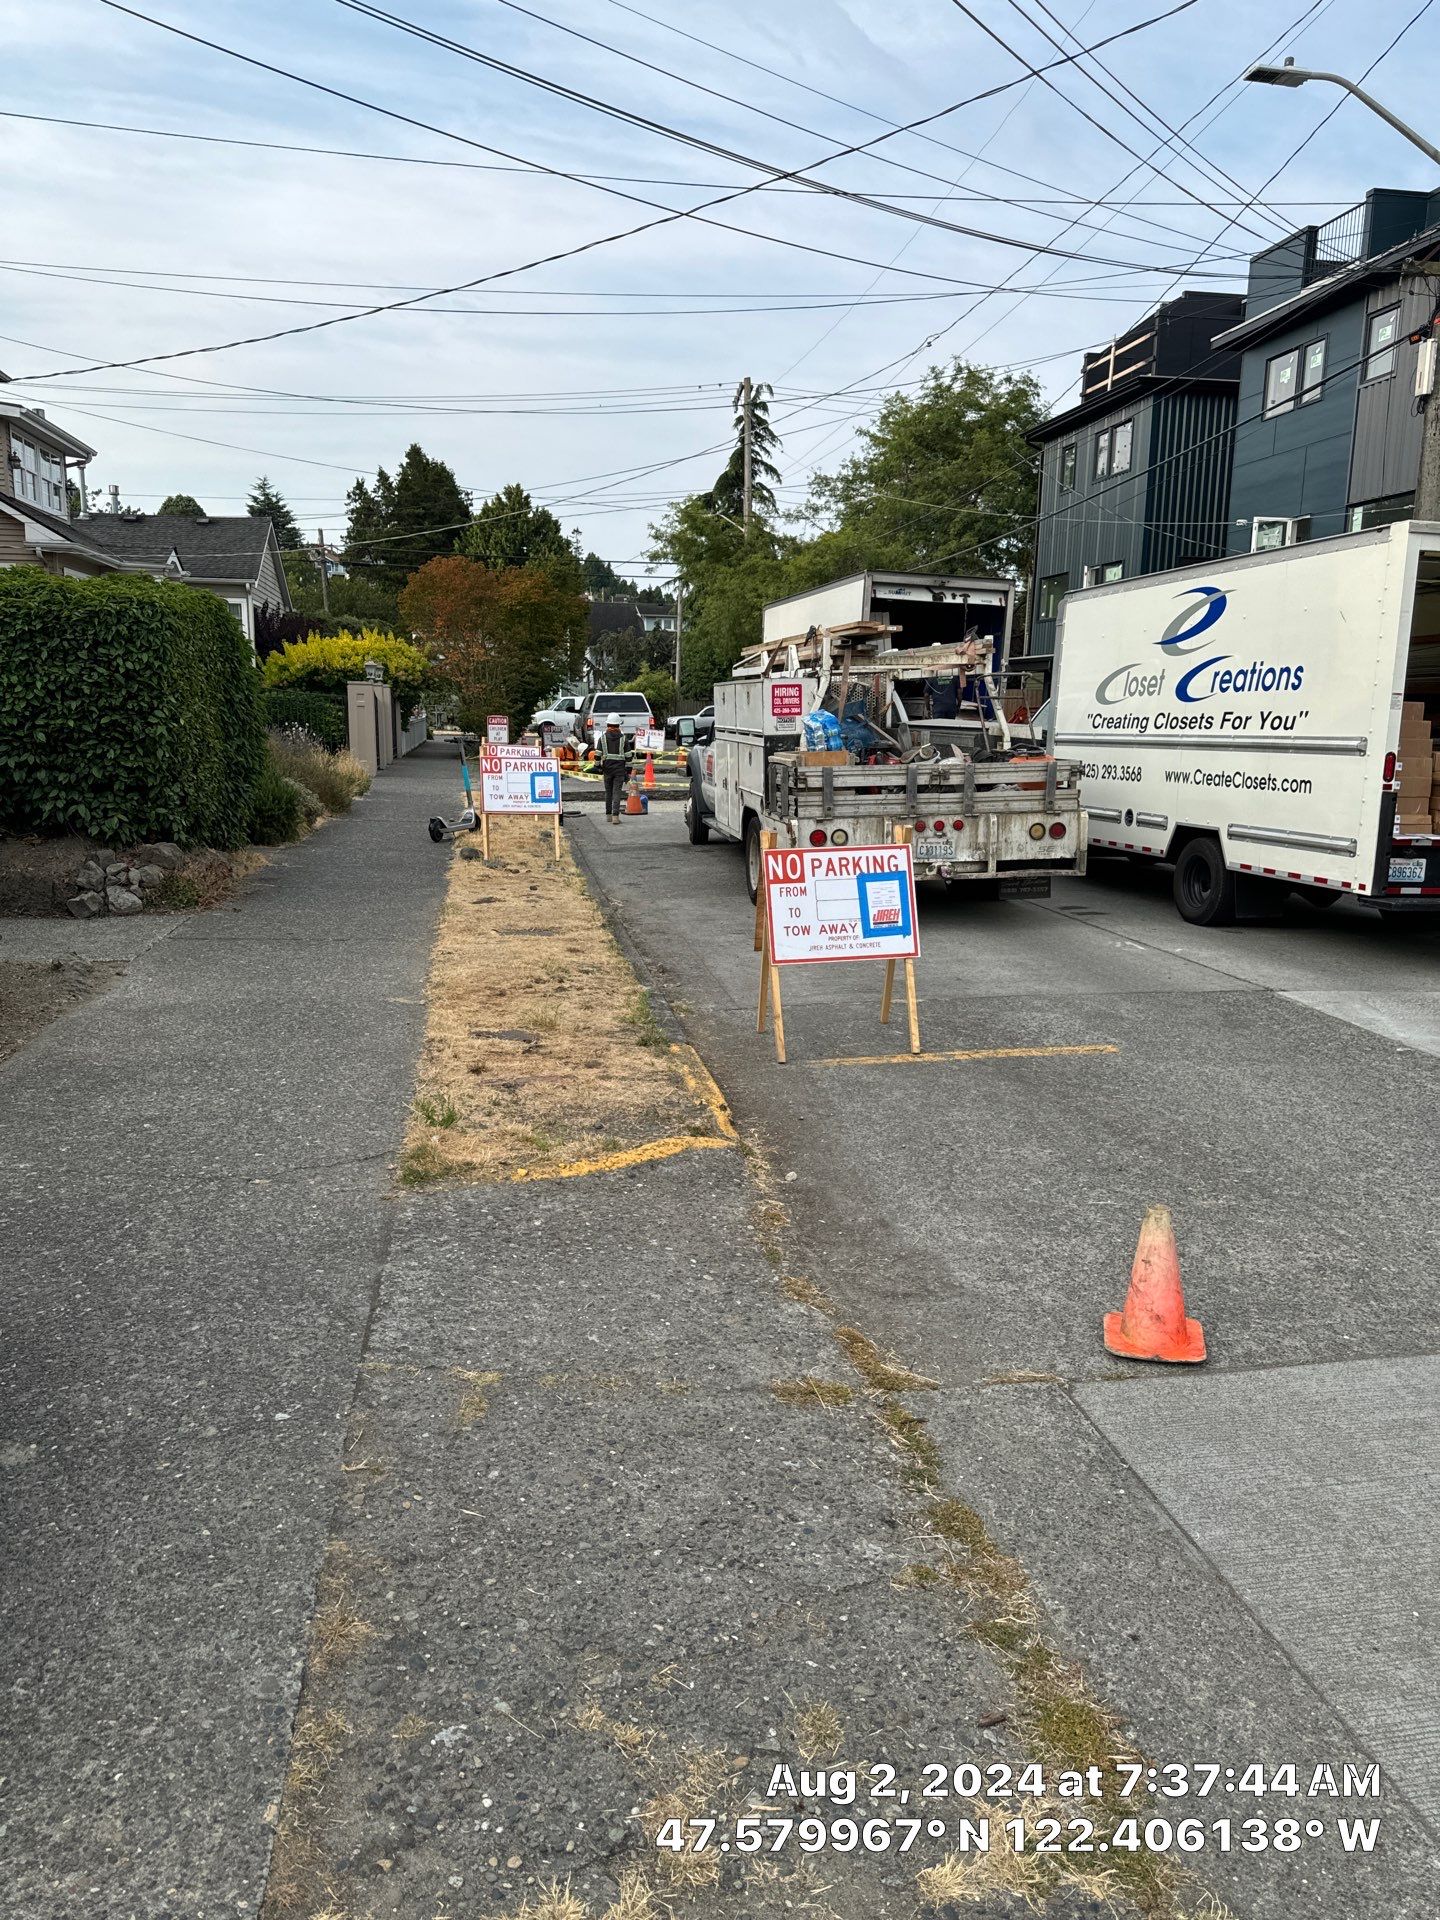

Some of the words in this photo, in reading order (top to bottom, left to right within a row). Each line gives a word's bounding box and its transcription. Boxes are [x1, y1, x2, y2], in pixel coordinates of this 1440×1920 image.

[1095, 663, 1166, 706] Closet
[1175, 655, 1304, 703] Creations
[774, 687, 800, 697] HIRING
[1087, 713, 1149, 733] "Creating
[1153, 712, 1215, 730] Closets
[1219, 711, 1252, 730] For
[1259, 710, 1309, 731] You"
[499, 747, 536, 756] PARKING
[482, 759, 500, 772] NO
[505, 761, 553, 772] PARKING
[1101, 763, 1142, 783] 293.3568
[1164, 768, 1313, 795] www.CreateClosets.com
[767, 853, 802, 880] NO
[811, 855, 899, 877] PARKING
[1388, 866, 1423, 879] 89636Z
[779, 886, 807, 898] FROM
[788, 907, 802, 918] TO
[872, 908, 901, 922] JIREH
[783, 925, 811, 937] TOW
[818, 922, 858, 935] AWAY
